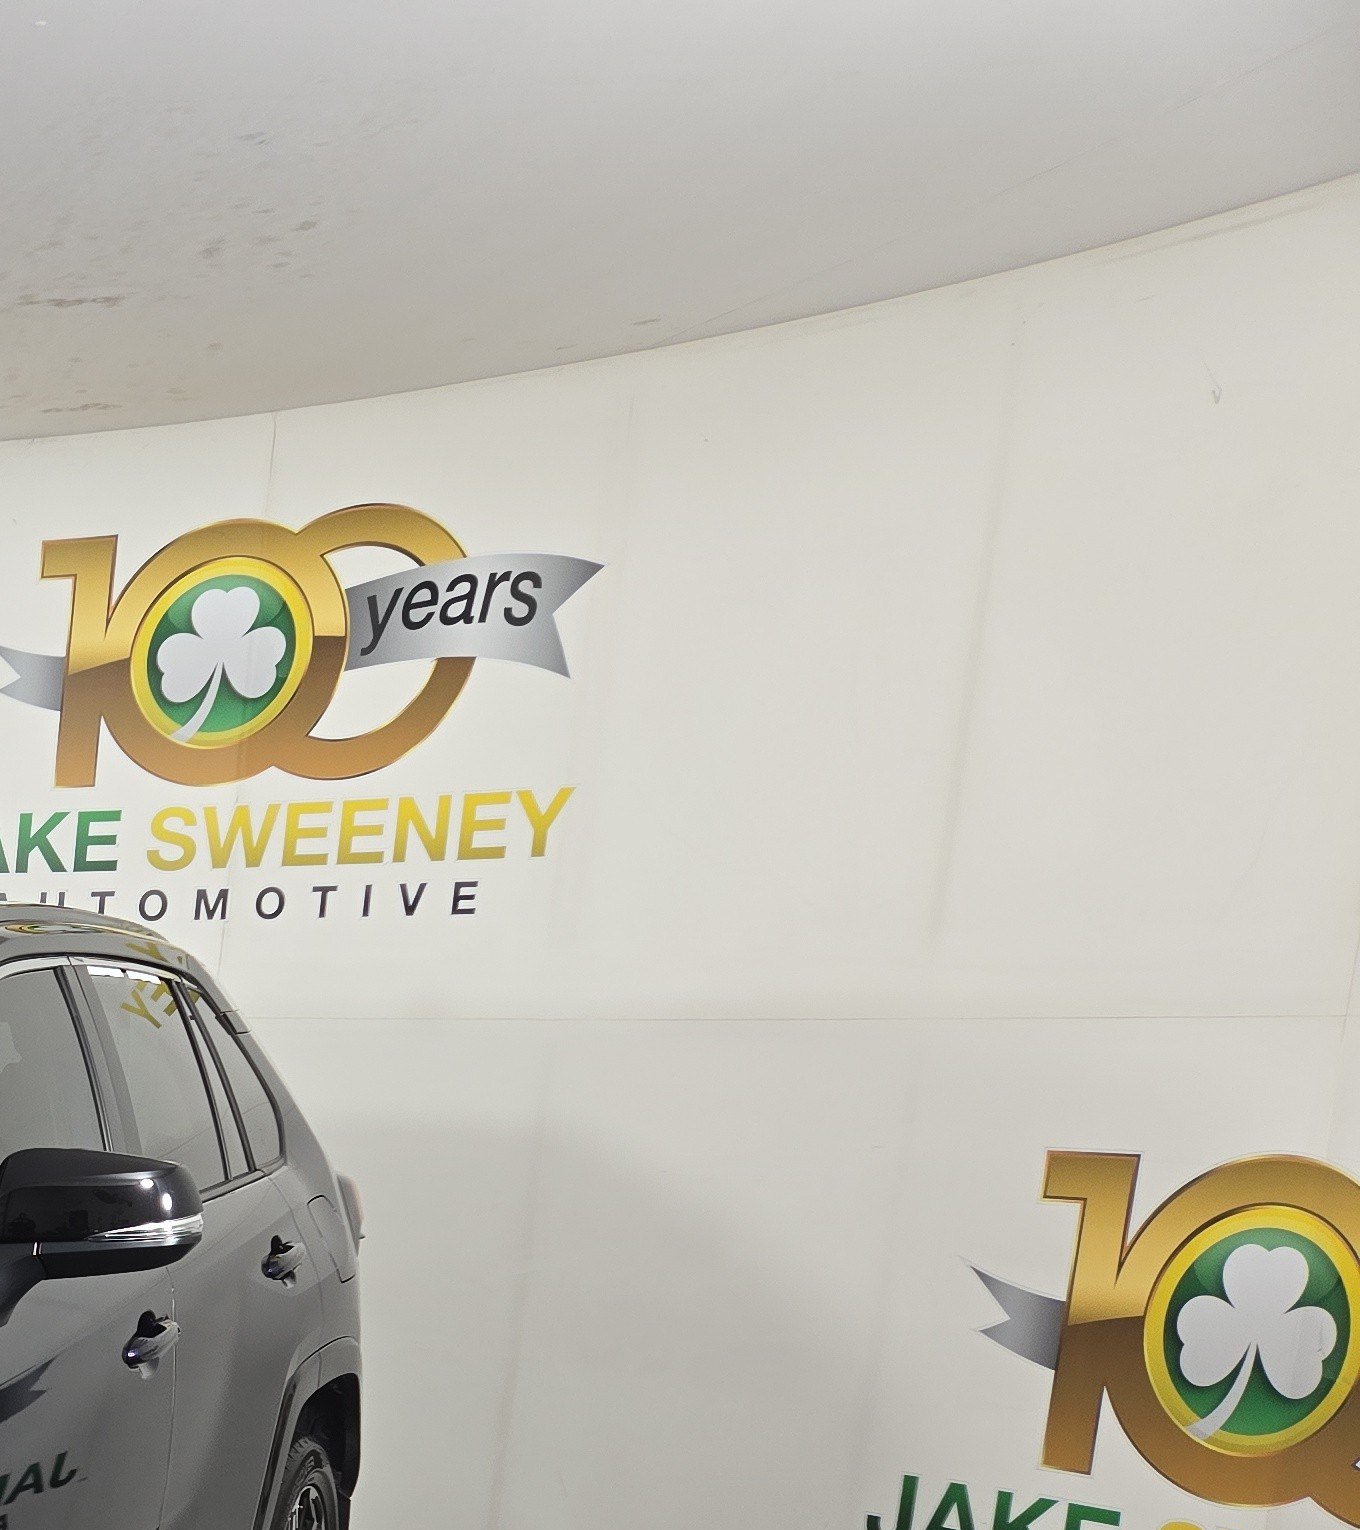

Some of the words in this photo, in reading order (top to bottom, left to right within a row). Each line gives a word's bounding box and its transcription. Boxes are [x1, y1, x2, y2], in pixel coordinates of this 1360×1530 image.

[38, 502, 478, 789] 100
[360, 570, 543, 656] years
[146, 787, 576, 872] SWEENEY
